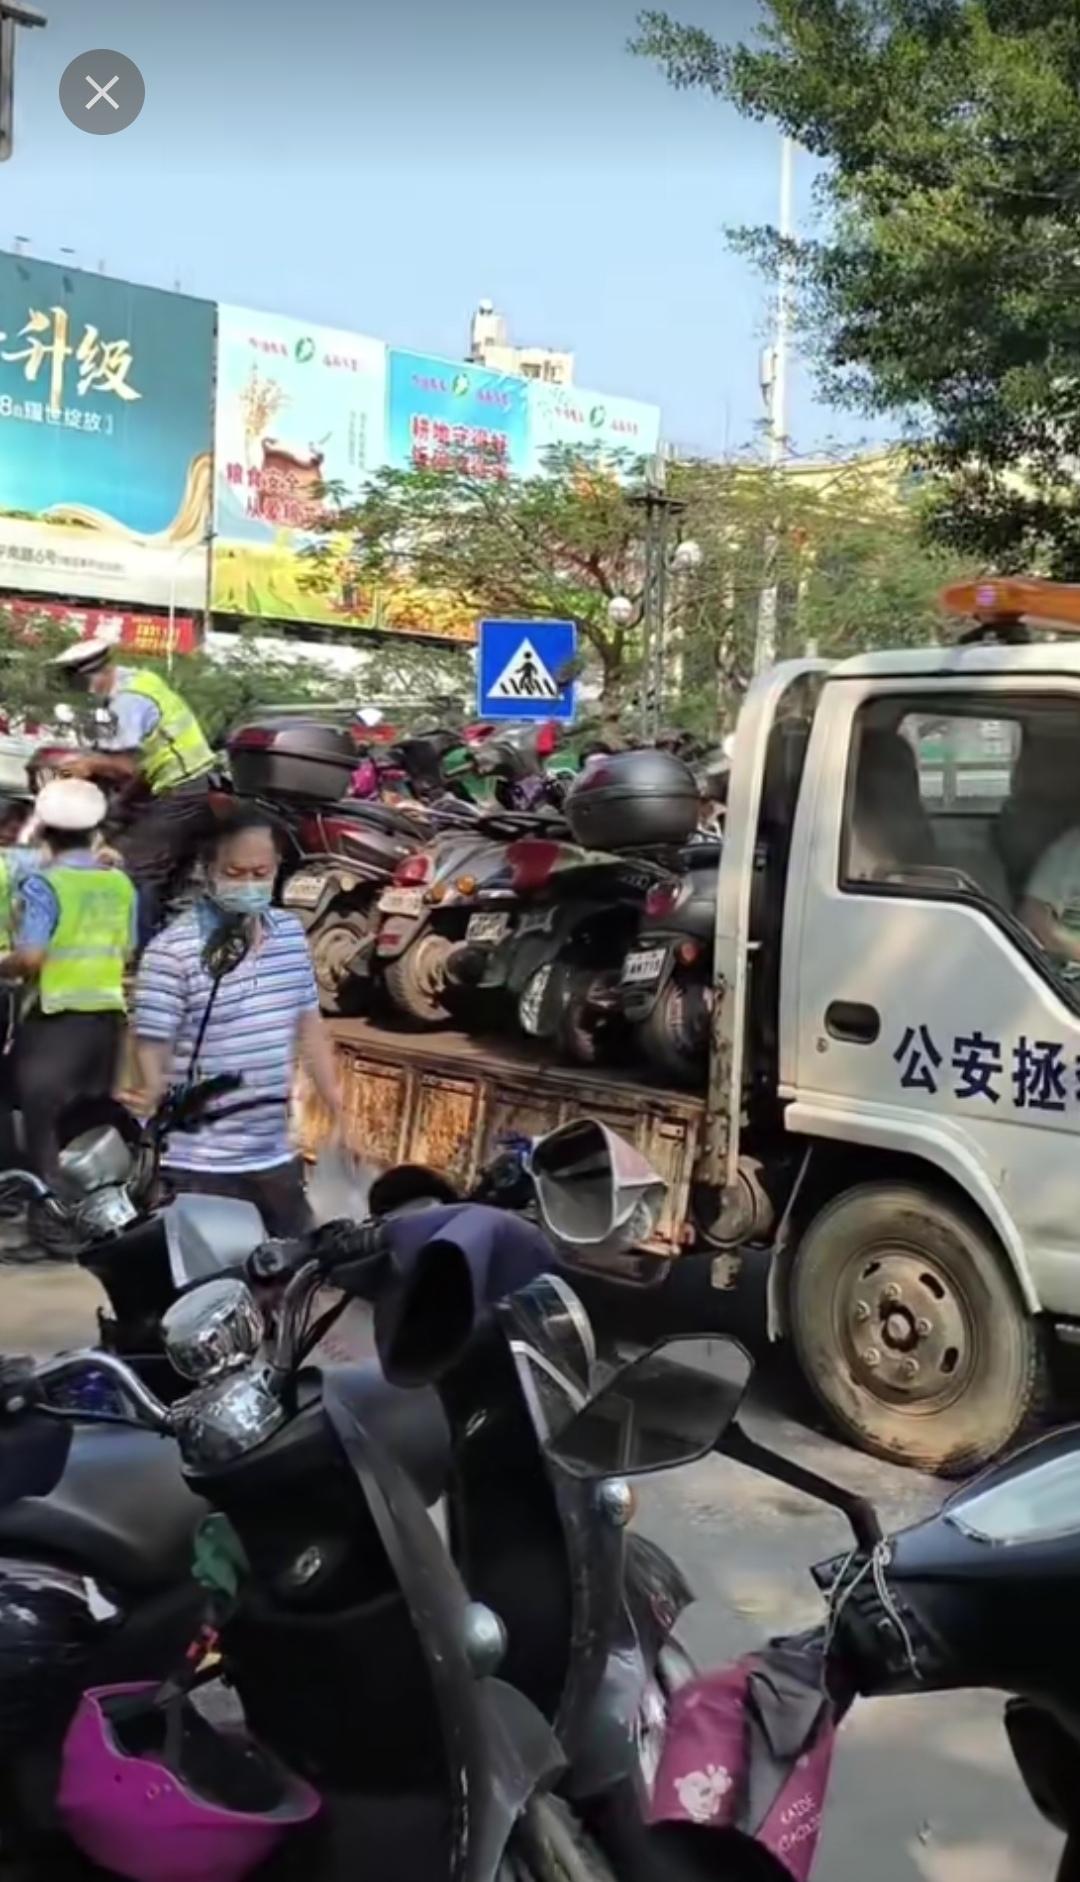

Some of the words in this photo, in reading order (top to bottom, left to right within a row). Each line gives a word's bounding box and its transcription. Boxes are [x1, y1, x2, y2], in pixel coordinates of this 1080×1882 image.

[0, 305, 142, 413] 升级
[893, 1023, 1080, 1111] 公安拯
